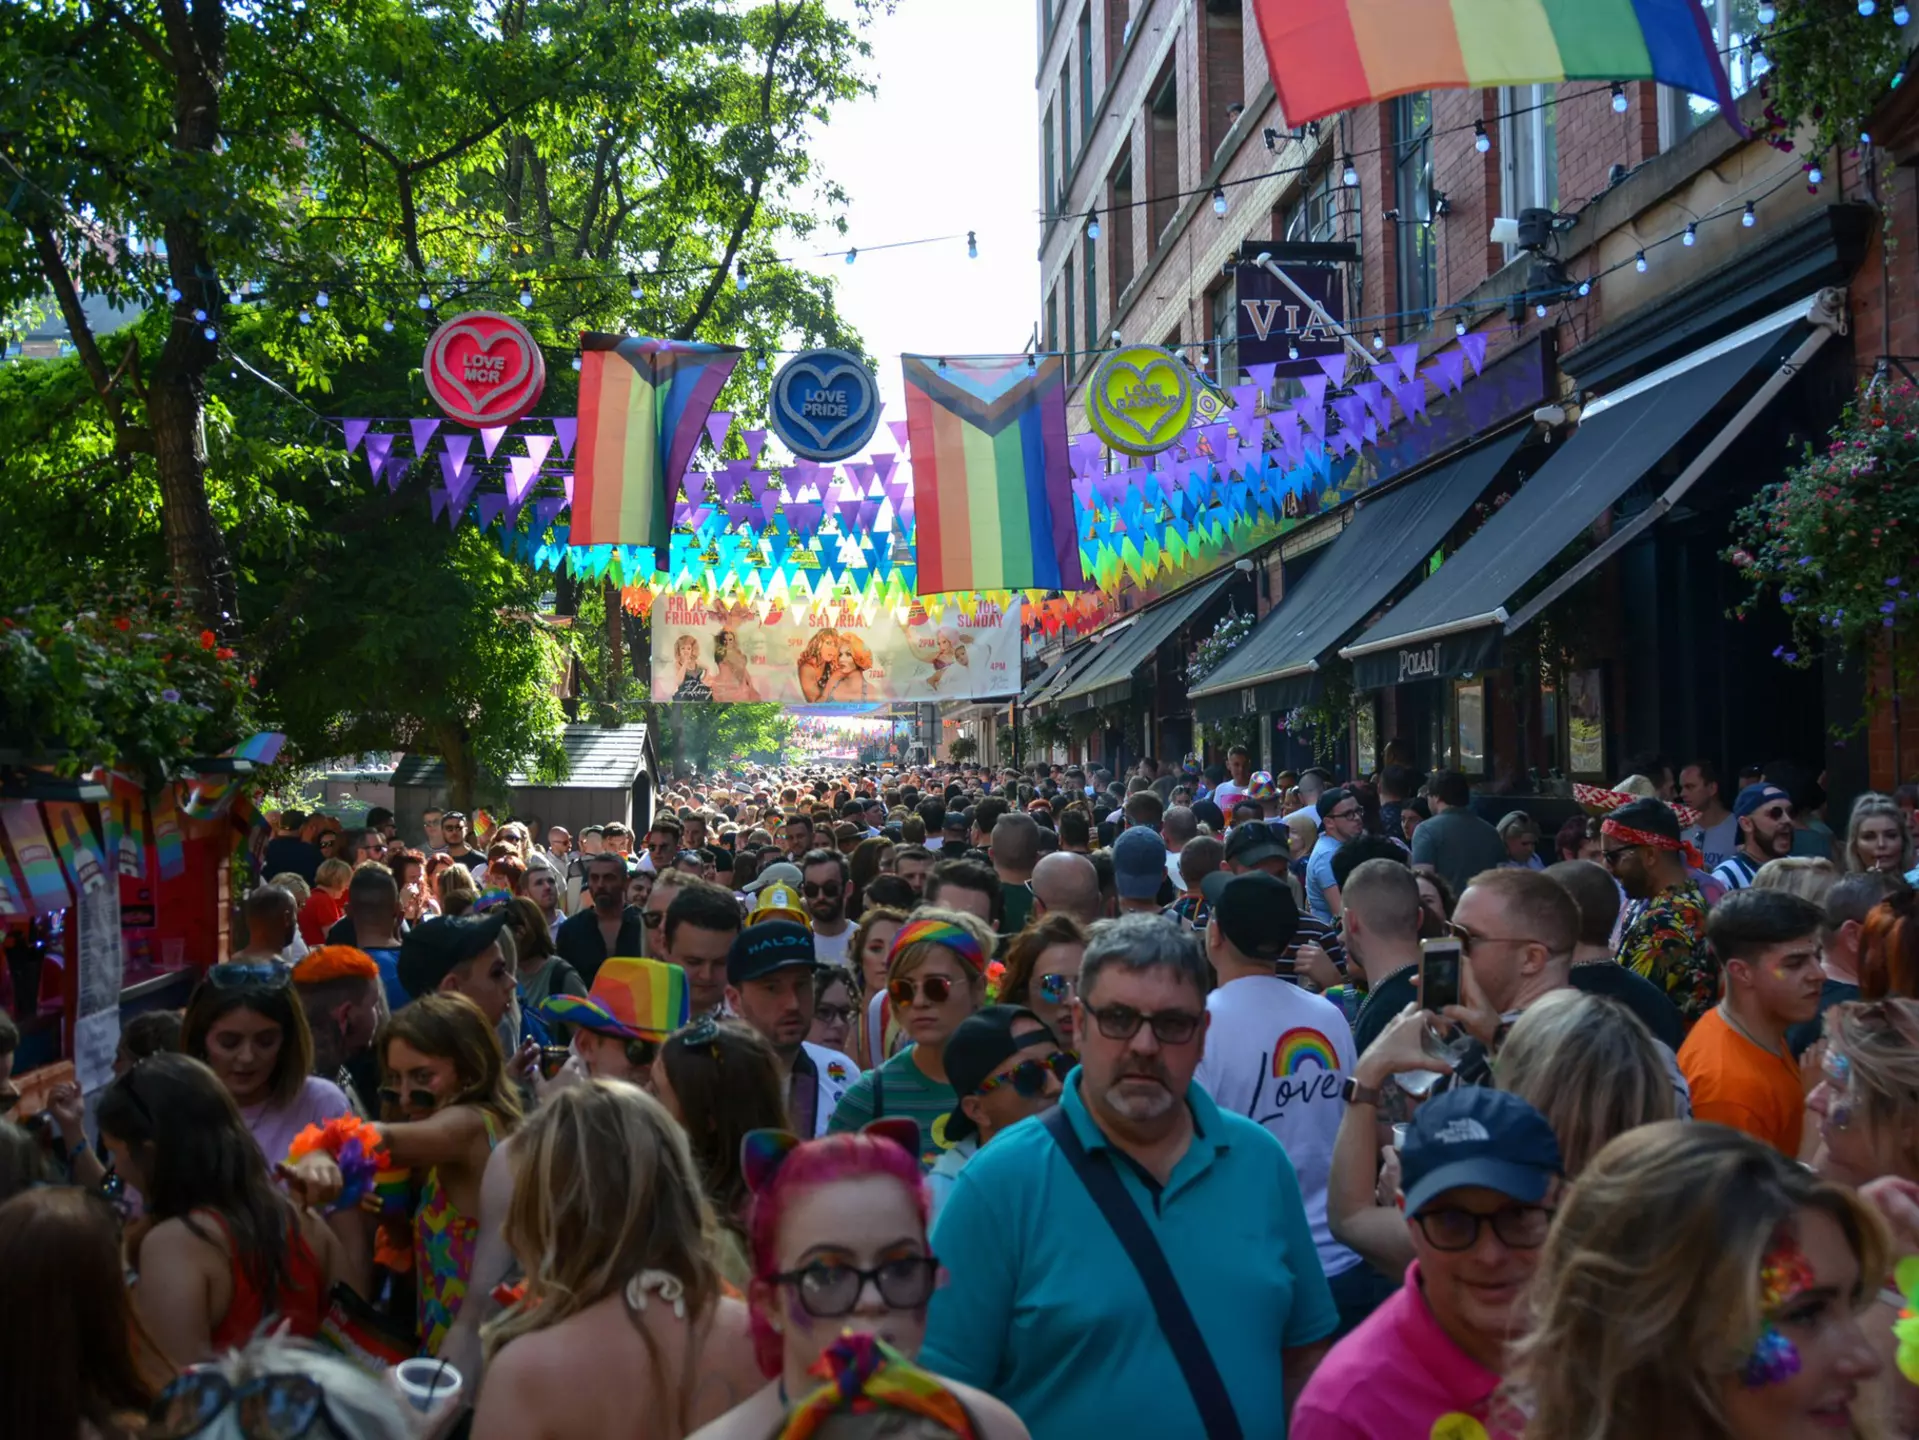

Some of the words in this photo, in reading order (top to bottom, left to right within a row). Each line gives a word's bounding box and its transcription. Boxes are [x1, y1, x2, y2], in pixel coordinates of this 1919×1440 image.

[1241, 299, 1340, 342] VIA
[462, 353, 505, 370] LOVE
[464, 368, 500, 383] MCR
[805, 389, 847, 402] LOVE
[1124, 383, 1163, 399] LOVE
[802, 403, 848, 417] PRIDE
[665, 611, 708, 626] FRIDAY
[957, 614, 1004, 628] SUNDAY
[990, 662, 1006, 671] 4PM
[1397, 642, 1443, 683] POLARI
[1241, 687, 1257, 713] VIA
[1248, 1052, 1339, 1125] Love
